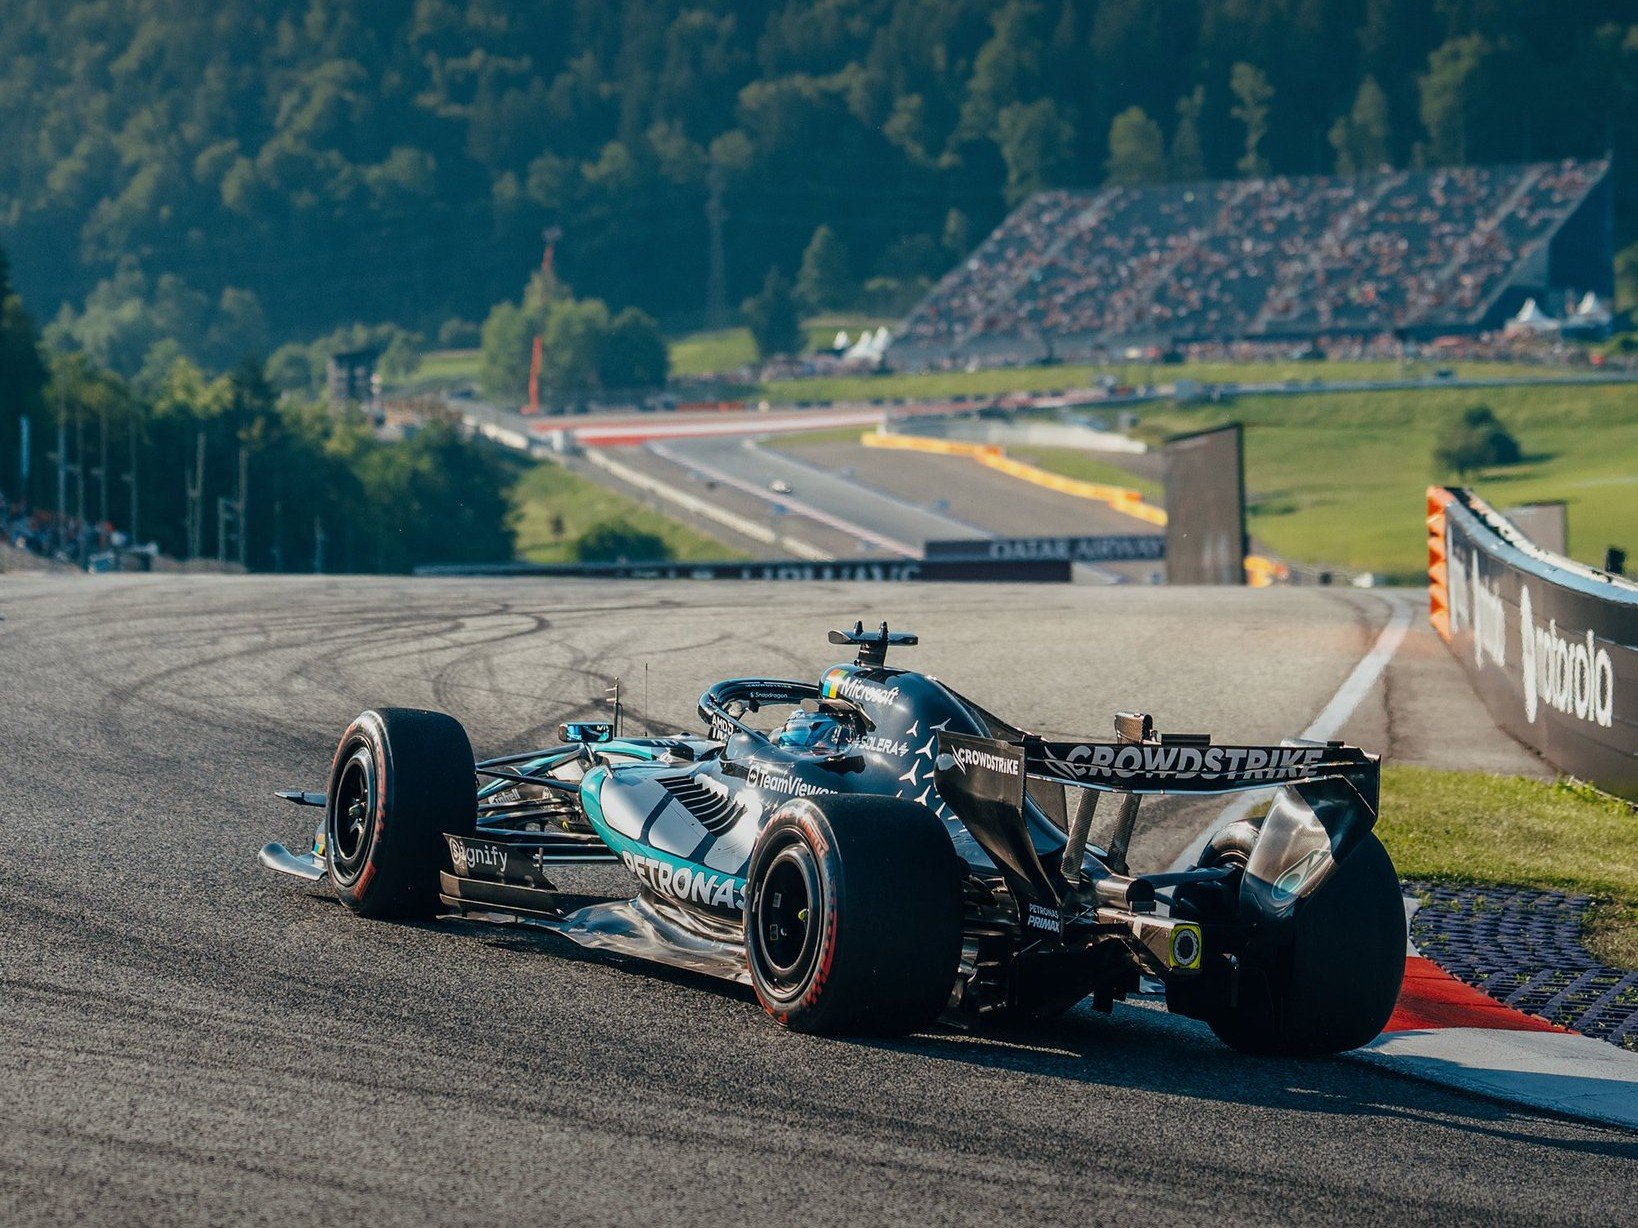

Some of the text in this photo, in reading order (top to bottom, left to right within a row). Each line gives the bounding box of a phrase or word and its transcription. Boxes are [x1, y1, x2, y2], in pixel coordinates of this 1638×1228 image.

[989, 542, 1069, 560] QATAR
[755, 691, 788, 700] Snapdragon
[840, 676, 899, 705] Microsoft
[859, 735, 899, 755] SOLERA
[958, 747, 1018, 775] CROWDSTRIKE
[1065, 745, 1323, 780] CROWDSTRIKE
[1029, 903, 1059, 919] PETRONAS
[1028, 915, 1060, 933] PRIMAX
